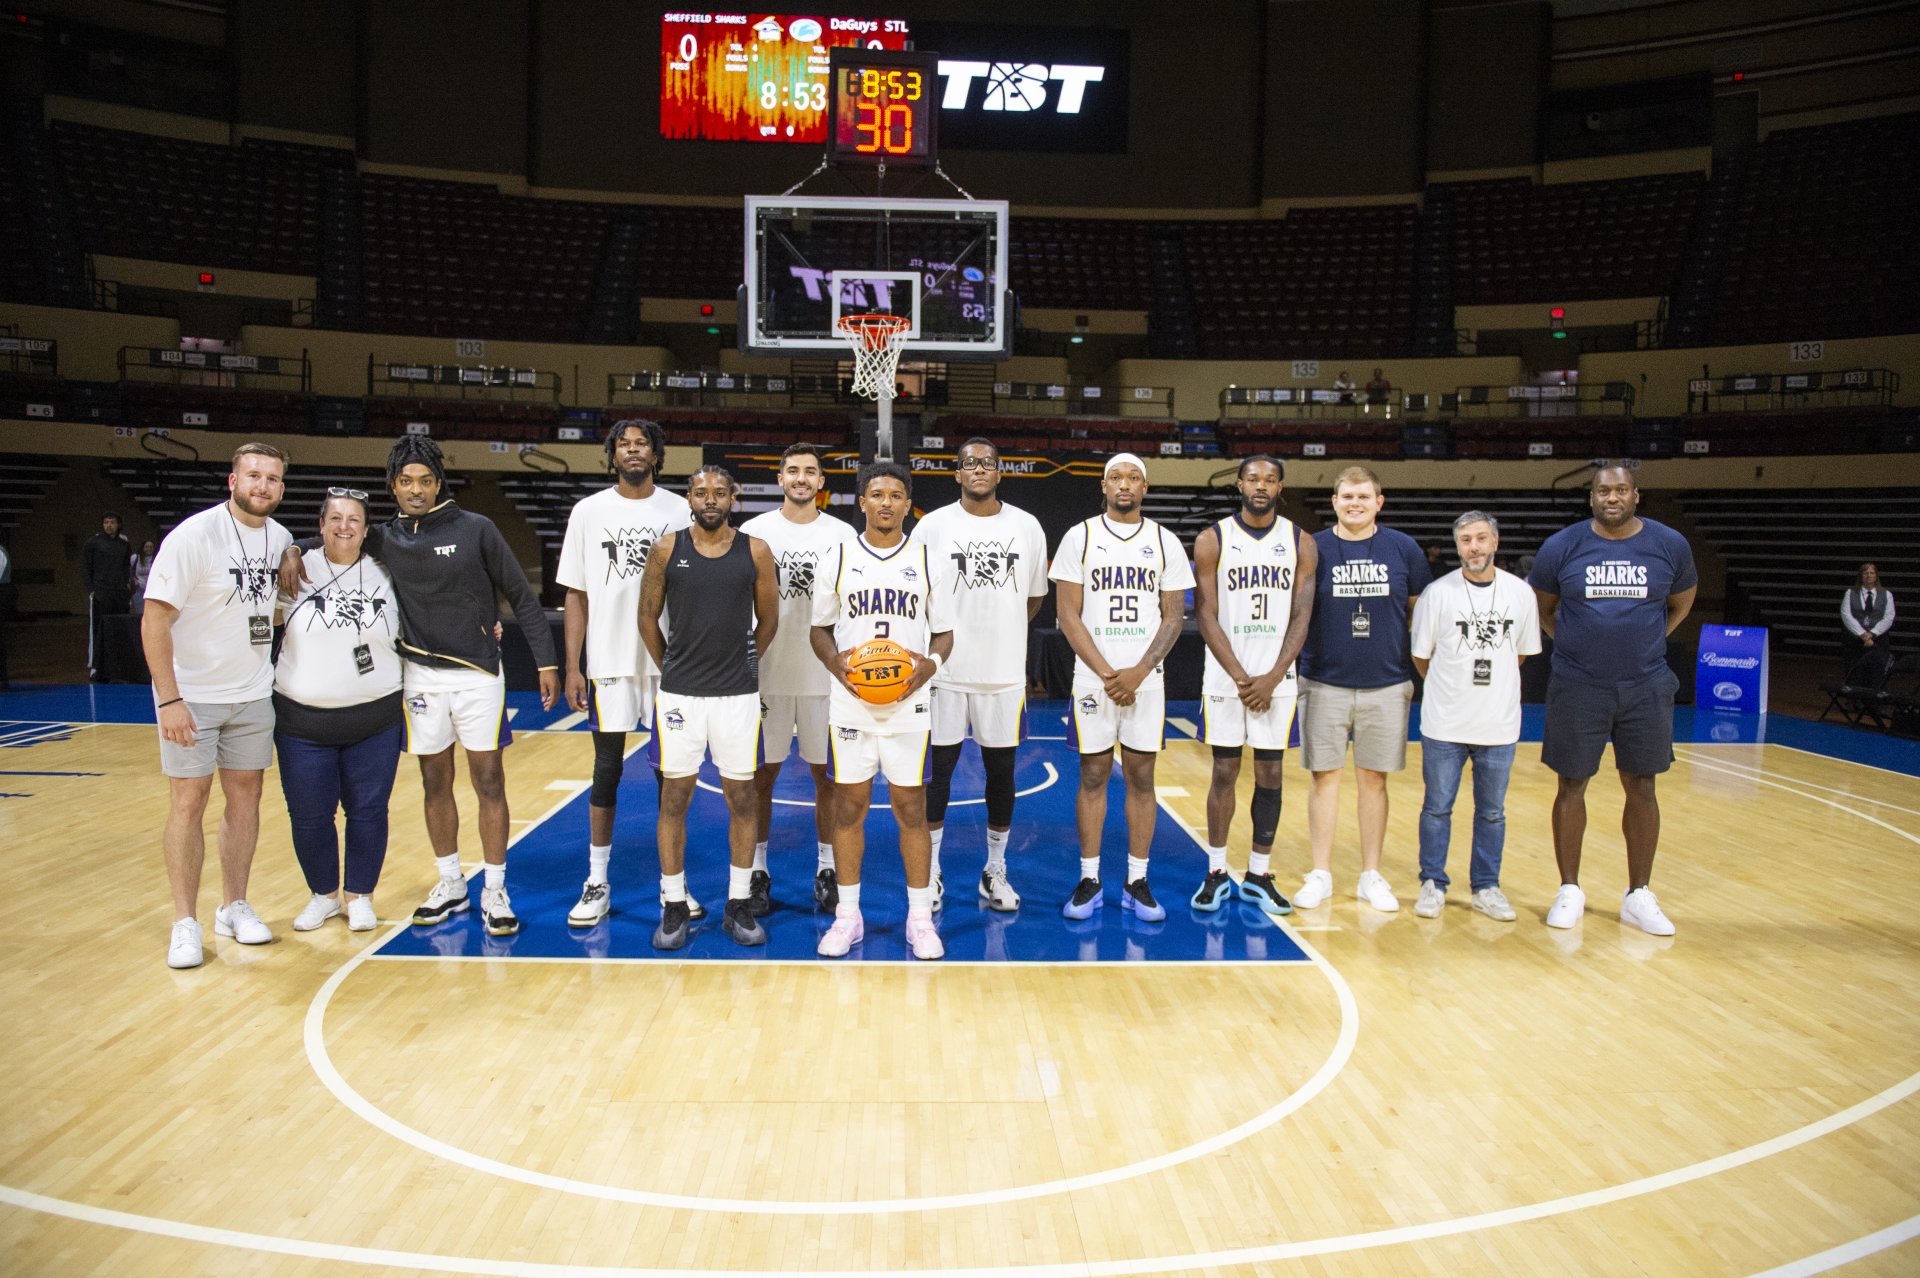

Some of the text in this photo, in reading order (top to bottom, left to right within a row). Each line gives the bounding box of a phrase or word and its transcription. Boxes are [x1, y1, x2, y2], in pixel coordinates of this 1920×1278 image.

[664, 13, 747, 25] SHEFFIELD SHARKS
[830, 18, 910, 34] DaGuys STL
[680, 33, 698, 62] 0
[863, 70, 922, 100] 8:53
[938, 60, 1105, 114] TBT
[760, 81, 827, 111] 8:53
[856, 102, 912, 153] 30
[27, 341, 46, 350] 105
[458, 341, 482, 356] 103
[1793, 343, 1822, 360] 133
[162, 352, 181, 361] 104
[1295, 362, 1317, 377] 135
[1845, 373, 1866, 382] 133
[43, 408, 51, 416] 6
[910, 458, 948, 471] TBALL
[602, 538, 655, 570] TB
[951, 551, 1020, 579] TBT
[1331, 563, 1388, 584] SHARKS
[1585, 565, 1648, 585] SHARKS
[1091, 566, 1156, 593] SHARKS
[1228, 565, 1291, 591] SHARKS
[1339, 586, 1383, 595] BASKETBALL
[848, 588, 919, 620] SHARKS
[1109, 595, 1139, 623] 25
[1251, 593, 1268, 620] 31
[1105, 627, 1146, 636] BRAUN
[1243, 624, 1277, 634] BRAUN
[1456, 620, 1514, 643] TBT
[861, 665, 902, 681] TBT
